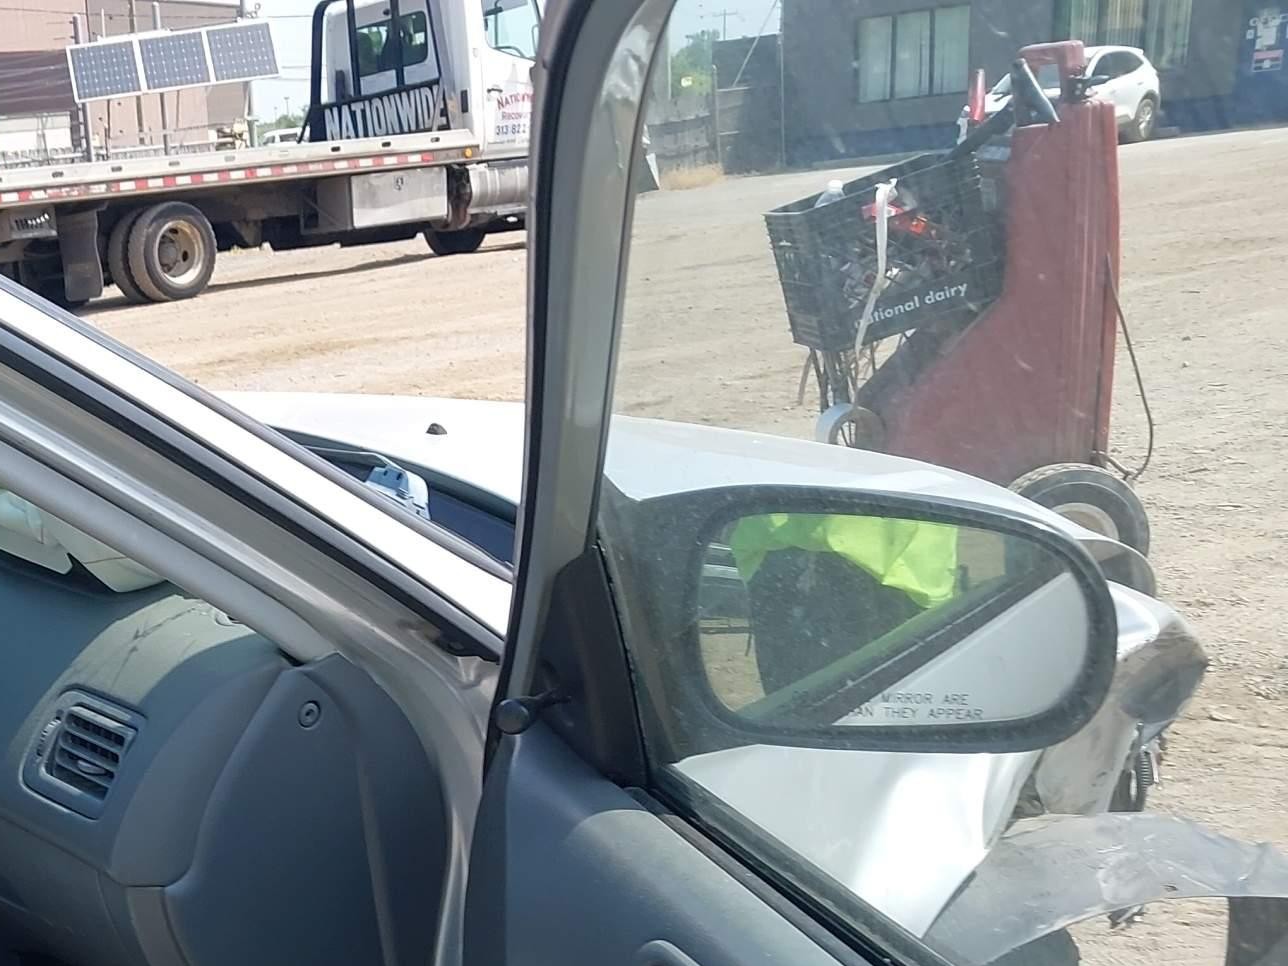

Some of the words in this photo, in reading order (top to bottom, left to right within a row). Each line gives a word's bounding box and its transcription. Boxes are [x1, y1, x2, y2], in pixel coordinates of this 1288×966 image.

[324, 84, 447, 142] NATIONWIDE
[924, 283, 968, 305] dairy
[943, 693, 970, 706] ARE
[883, 705, 919, 719] THEY
[927, 707, 984, 721] APPEAR
